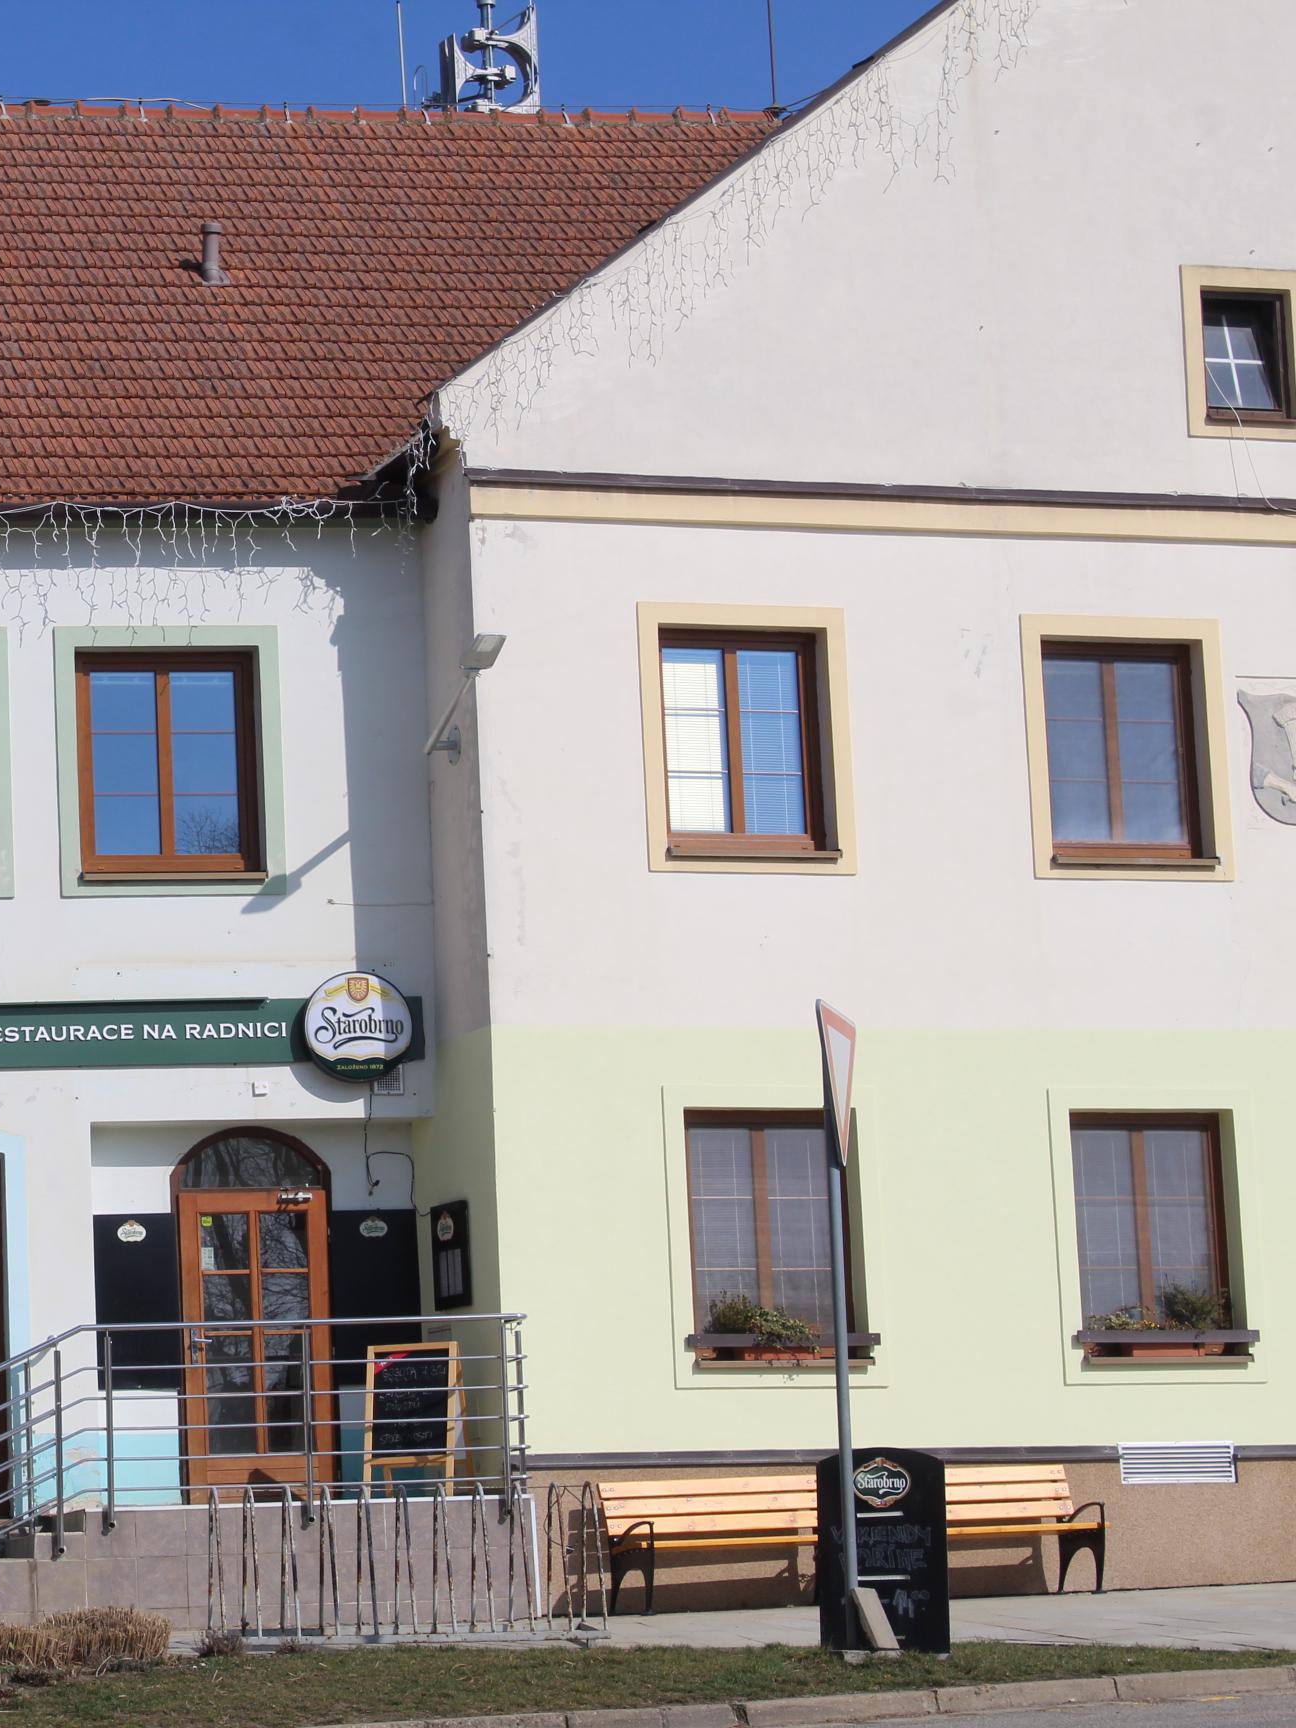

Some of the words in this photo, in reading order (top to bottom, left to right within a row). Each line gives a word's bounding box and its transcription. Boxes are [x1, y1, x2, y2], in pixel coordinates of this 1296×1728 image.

[143, 1023, 177, 1040] NA
[184, 1021, 288, 1040] RADNICI
[314, 1006, 404, 1050] Starobrno
[857, 1471, 906, 1495] Starobrno
[830, 1524, 932, 1546] VKENDY
